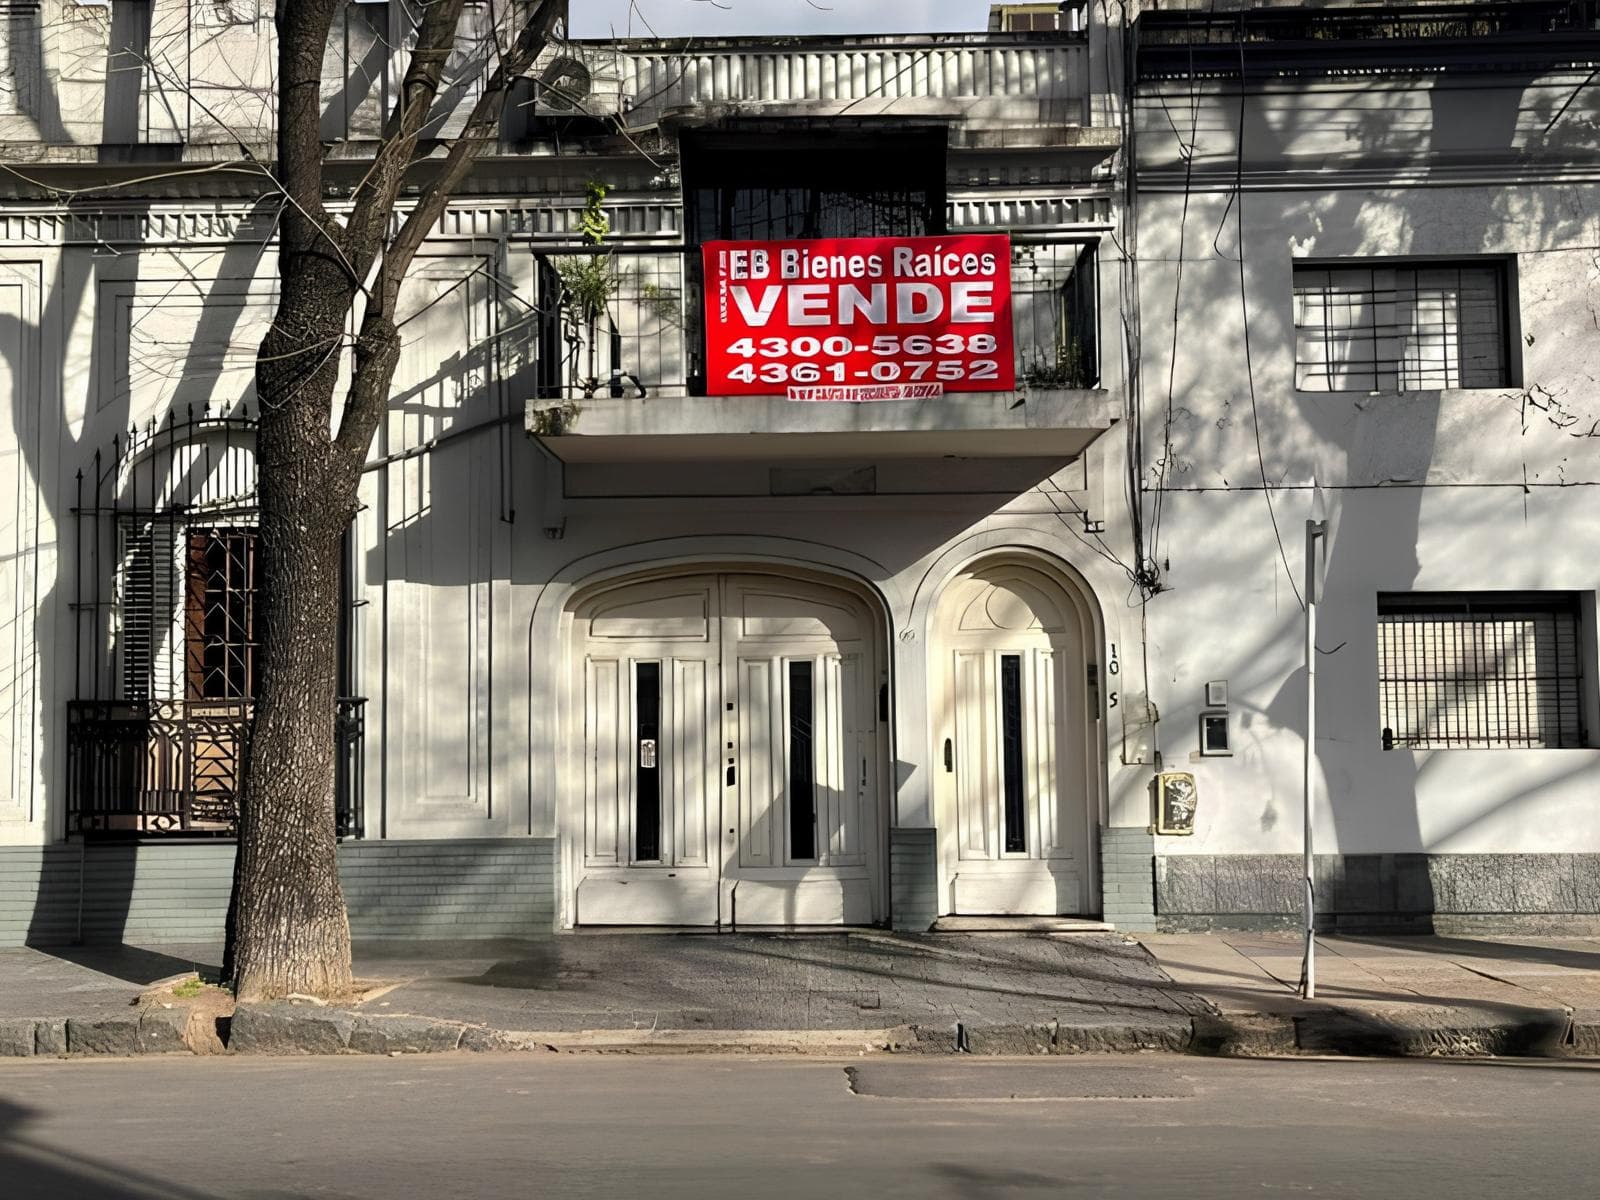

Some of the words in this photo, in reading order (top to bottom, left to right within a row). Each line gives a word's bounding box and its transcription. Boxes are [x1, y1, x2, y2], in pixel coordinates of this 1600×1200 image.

[781, 248, 883, 279] Bienes
[894, 246, 996, 276] Raíces
[729, 281, 995, 326] VENDE
[726, 334, 997, 357] 4300-5638
[726, 360, 999, 382] 4361-0752
